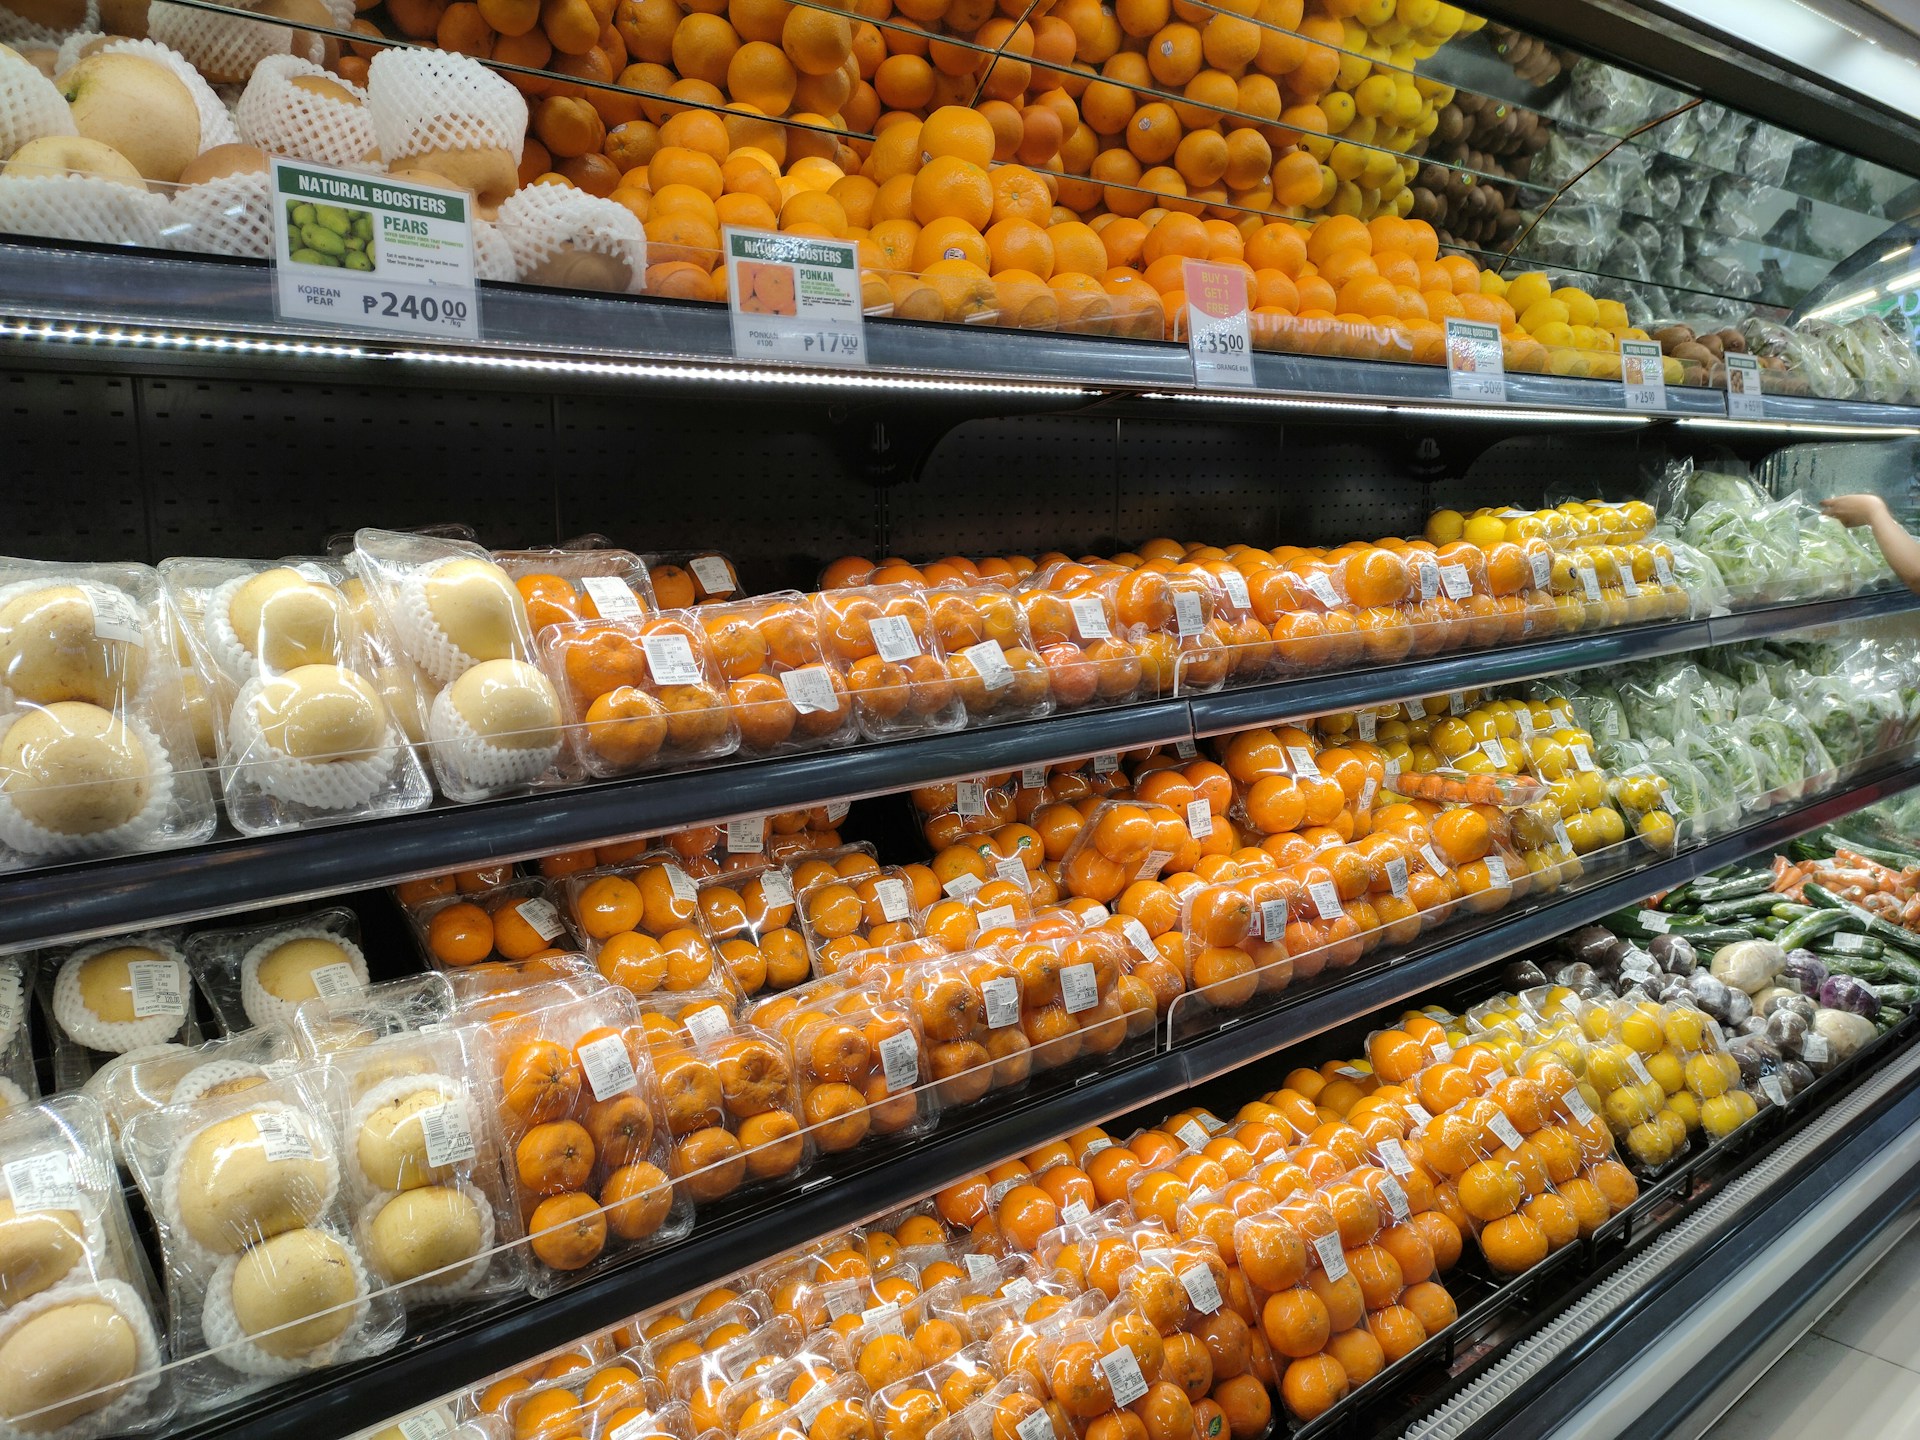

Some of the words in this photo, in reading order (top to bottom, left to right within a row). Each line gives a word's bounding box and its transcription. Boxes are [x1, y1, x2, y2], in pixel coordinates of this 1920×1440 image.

[299, 175, 369, 202] NATURAL
[373, 188, 447, 215] BOOSTERS
[383, 215, 428, 236] PEARS
[800, 268, 834, 282] PONKAN
[1202, 272, 1221, 284] BUY
[1223, 274, 1229, 284] 3
[298, 284, 341, 298] KOREAN
[1204, 287, 1224, 299] GET
[1225, 290, 1230, 300] 1
[306, 294, 334, 307] PEAR
[1206, 302, 1230, 314] FREE
[1216, 362, 1240, 372] ORANGE
